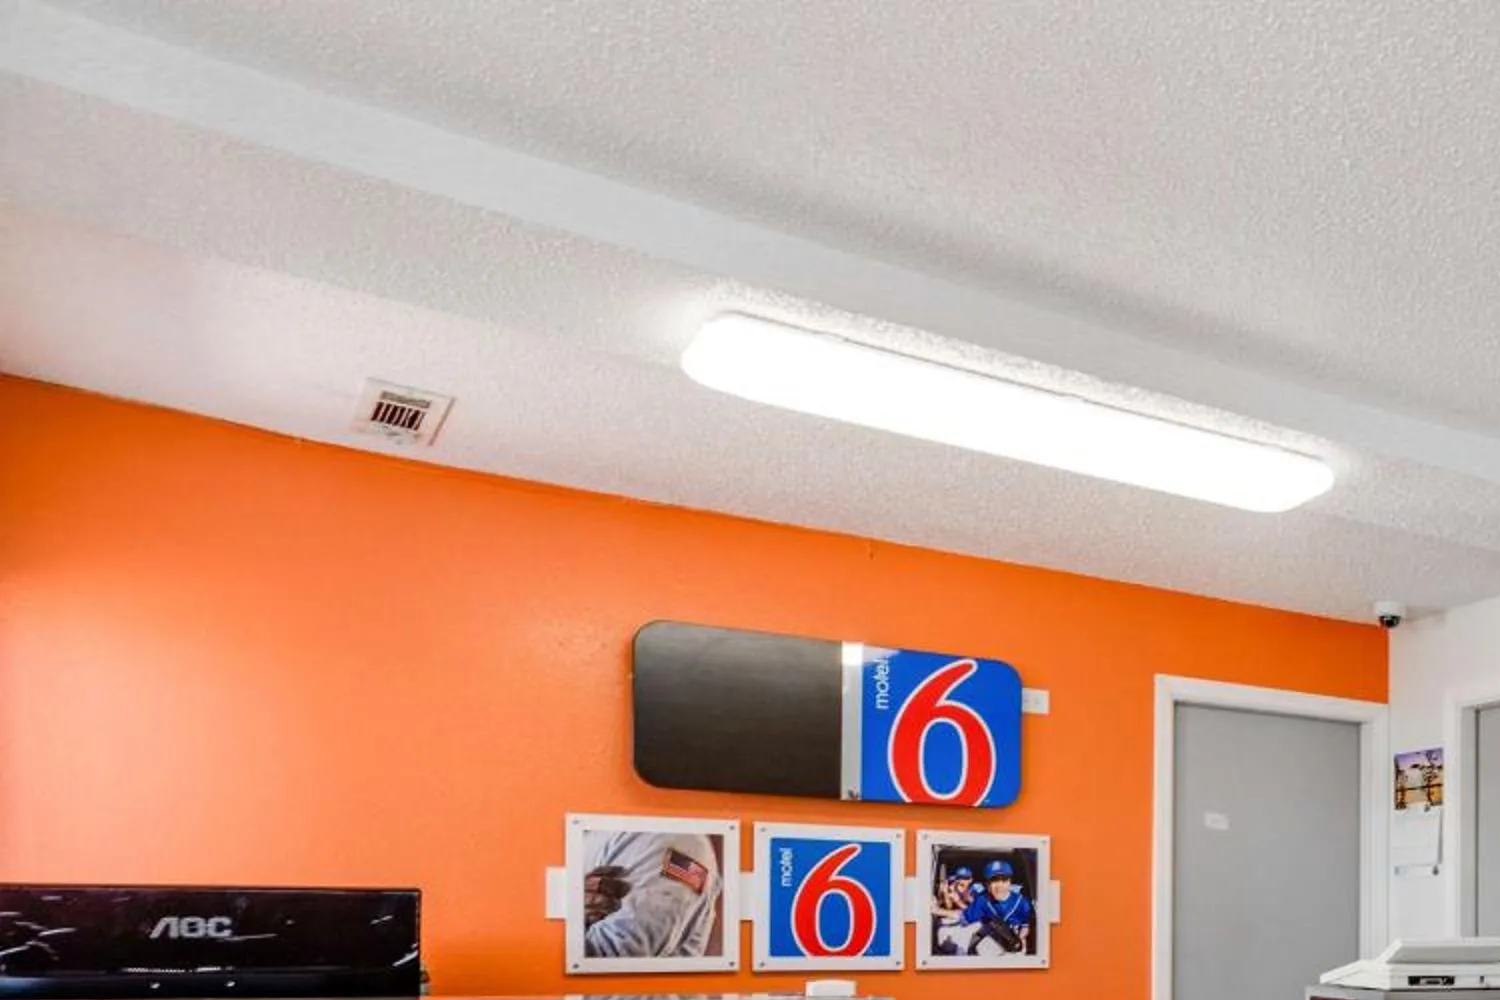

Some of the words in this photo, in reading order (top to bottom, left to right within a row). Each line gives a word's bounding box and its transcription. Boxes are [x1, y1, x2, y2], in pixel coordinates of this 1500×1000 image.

[874, 656, 890, 710] motel
[887, 658, 997, 808] 6
[150, 916, 233, 940] AOC
[781, 847, 793, 888] motel
[791, 843, 877, 957] 6
